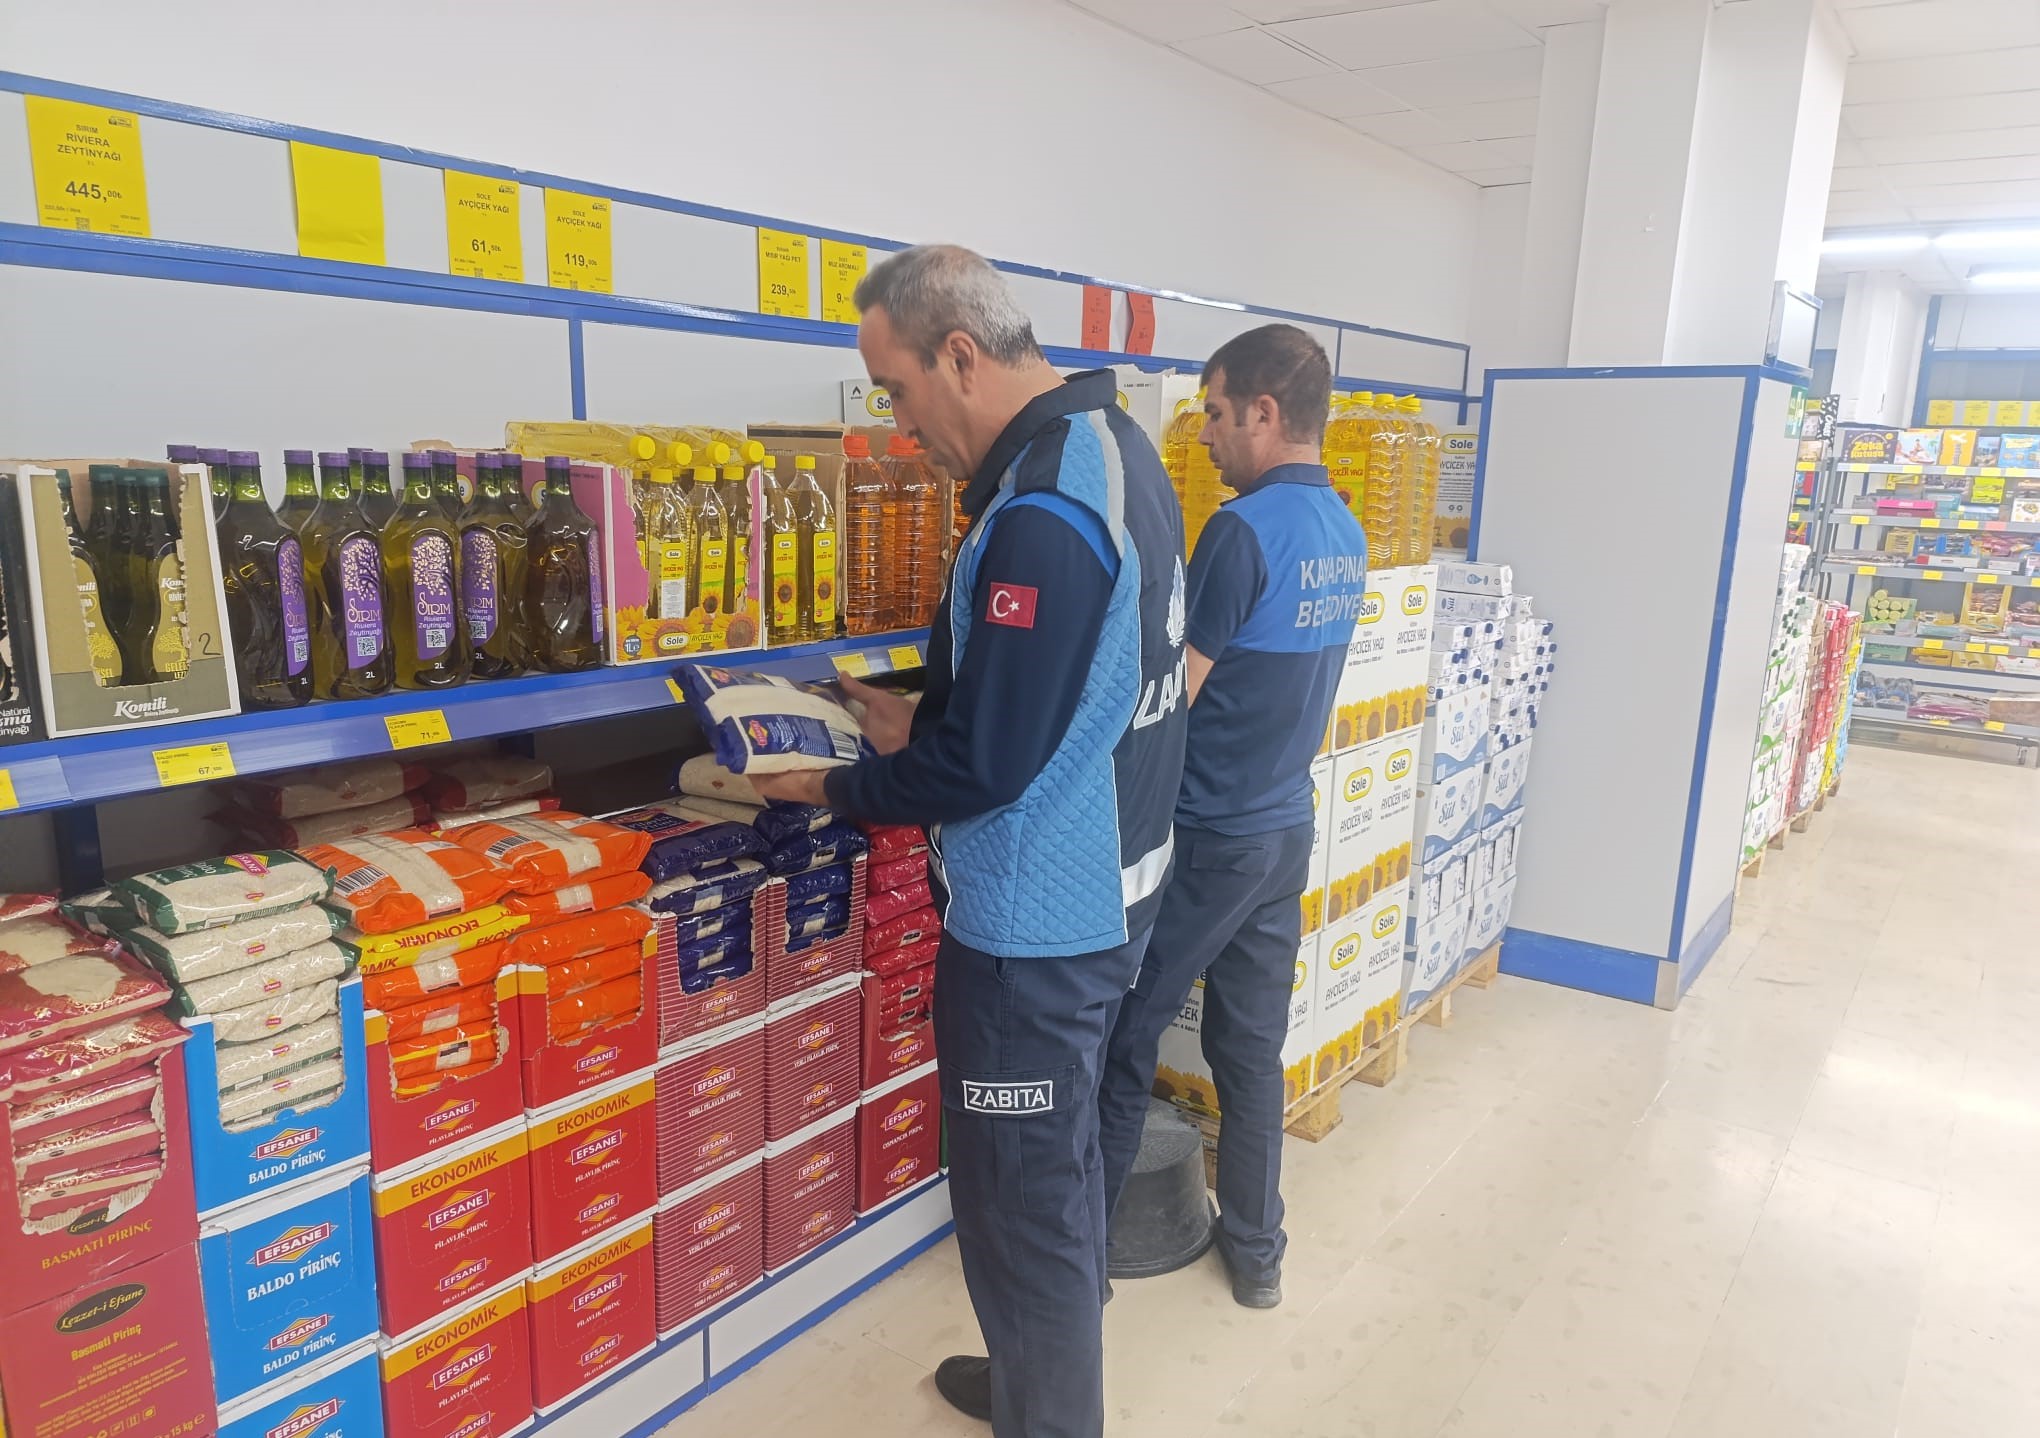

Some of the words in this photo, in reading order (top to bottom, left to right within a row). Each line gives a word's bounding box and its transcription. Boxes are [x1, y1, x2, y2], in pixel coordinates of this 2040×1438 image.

[877, 397, 890, 409] So
[1450, 439, 1473, 449] Sole
[1360, 602, 1377, 615] Sole
[1408, 595, 1421, 607] Sole
[198, 632, 221, 656] 2
[666, 636, 684, 645] Sole
[114, 697, 167, 719] Komili
[1392, 758, 1406, 773] Sole
[1351, 777, 1366, 793] Sole
[1379, 916, 1394, 930] Sole
[803, 956, 829, 967] EFSANE
[1337, 944, 1353, 961] Sole
[706, 995, 734, 1009] EFSANE
[802, 1026, 831, 1045] EFSANE
[581, 1051, 613, 1068] EFSANE
[894, 1043, 918, 1059] EFSANE
[698, 1071, 731, 1092] EFSANE
[807, 1086, 830, 1102] EFSANE
[968, 1087, 1046, 1108] ZABITA
[430, 1104, 470, 1126] EFSANE
[557, 1094, 631, 1135] EKONOMİK
[888, 1105, 918, 1126] EFSANE
[263, 1132, 312, 1154] EFSANE
[577, 1135, 617, 1159] EFSANE
[702, 1136, 730, 1153] EFSANE
[249, 1163, 287, 1184] BALDO
[291, 1149, 326, 1170] PİRİNÇ
[411, 1151, 498, 1198] EKONOMİK
[802, 1156, 831, 1176] EFSANE
[890, 1162, 915, 1179] EFSANE
[435, 1195, 483, 1224] EFSANE
[583, 1198, 615, 1218] EFSANE
[698, 1207, 731, 1229] EFSANE
[41, 1237, 103, 1269] BASMATİ
[108, 1219, 153, 1245] PİRİNÇ
[264, 1228, 322, 1260] EFSANE
[562, 1239, 632, 1285] EKONOMİK
[247, 1272, 294, 1301] BALDO
[300, 1252, 341, 1279] PİRİNÇ
[445, 1262, 482, 1287] EFSANE
[702, 1269, 730, 1288] EFSANE
[109, 1288, 144, 1309] Efsane
[578, 1279, 618, 1306] EFSANE
[276, 1320, 322, 1345] EFSANE
[416, 1305, 499, 1360] EKONOMİK
[71, 1336, 110, 1361] Basmati
[263, 1350, 299, 1374] BALDO
[303, 1333, 337, 1355] PİRİNÇ
[585, 1339, 616, 1362] EFSANE
[439, 1350, 485, 1384] EFSANE
[274, 1406, 330, 1438] EFSANE
